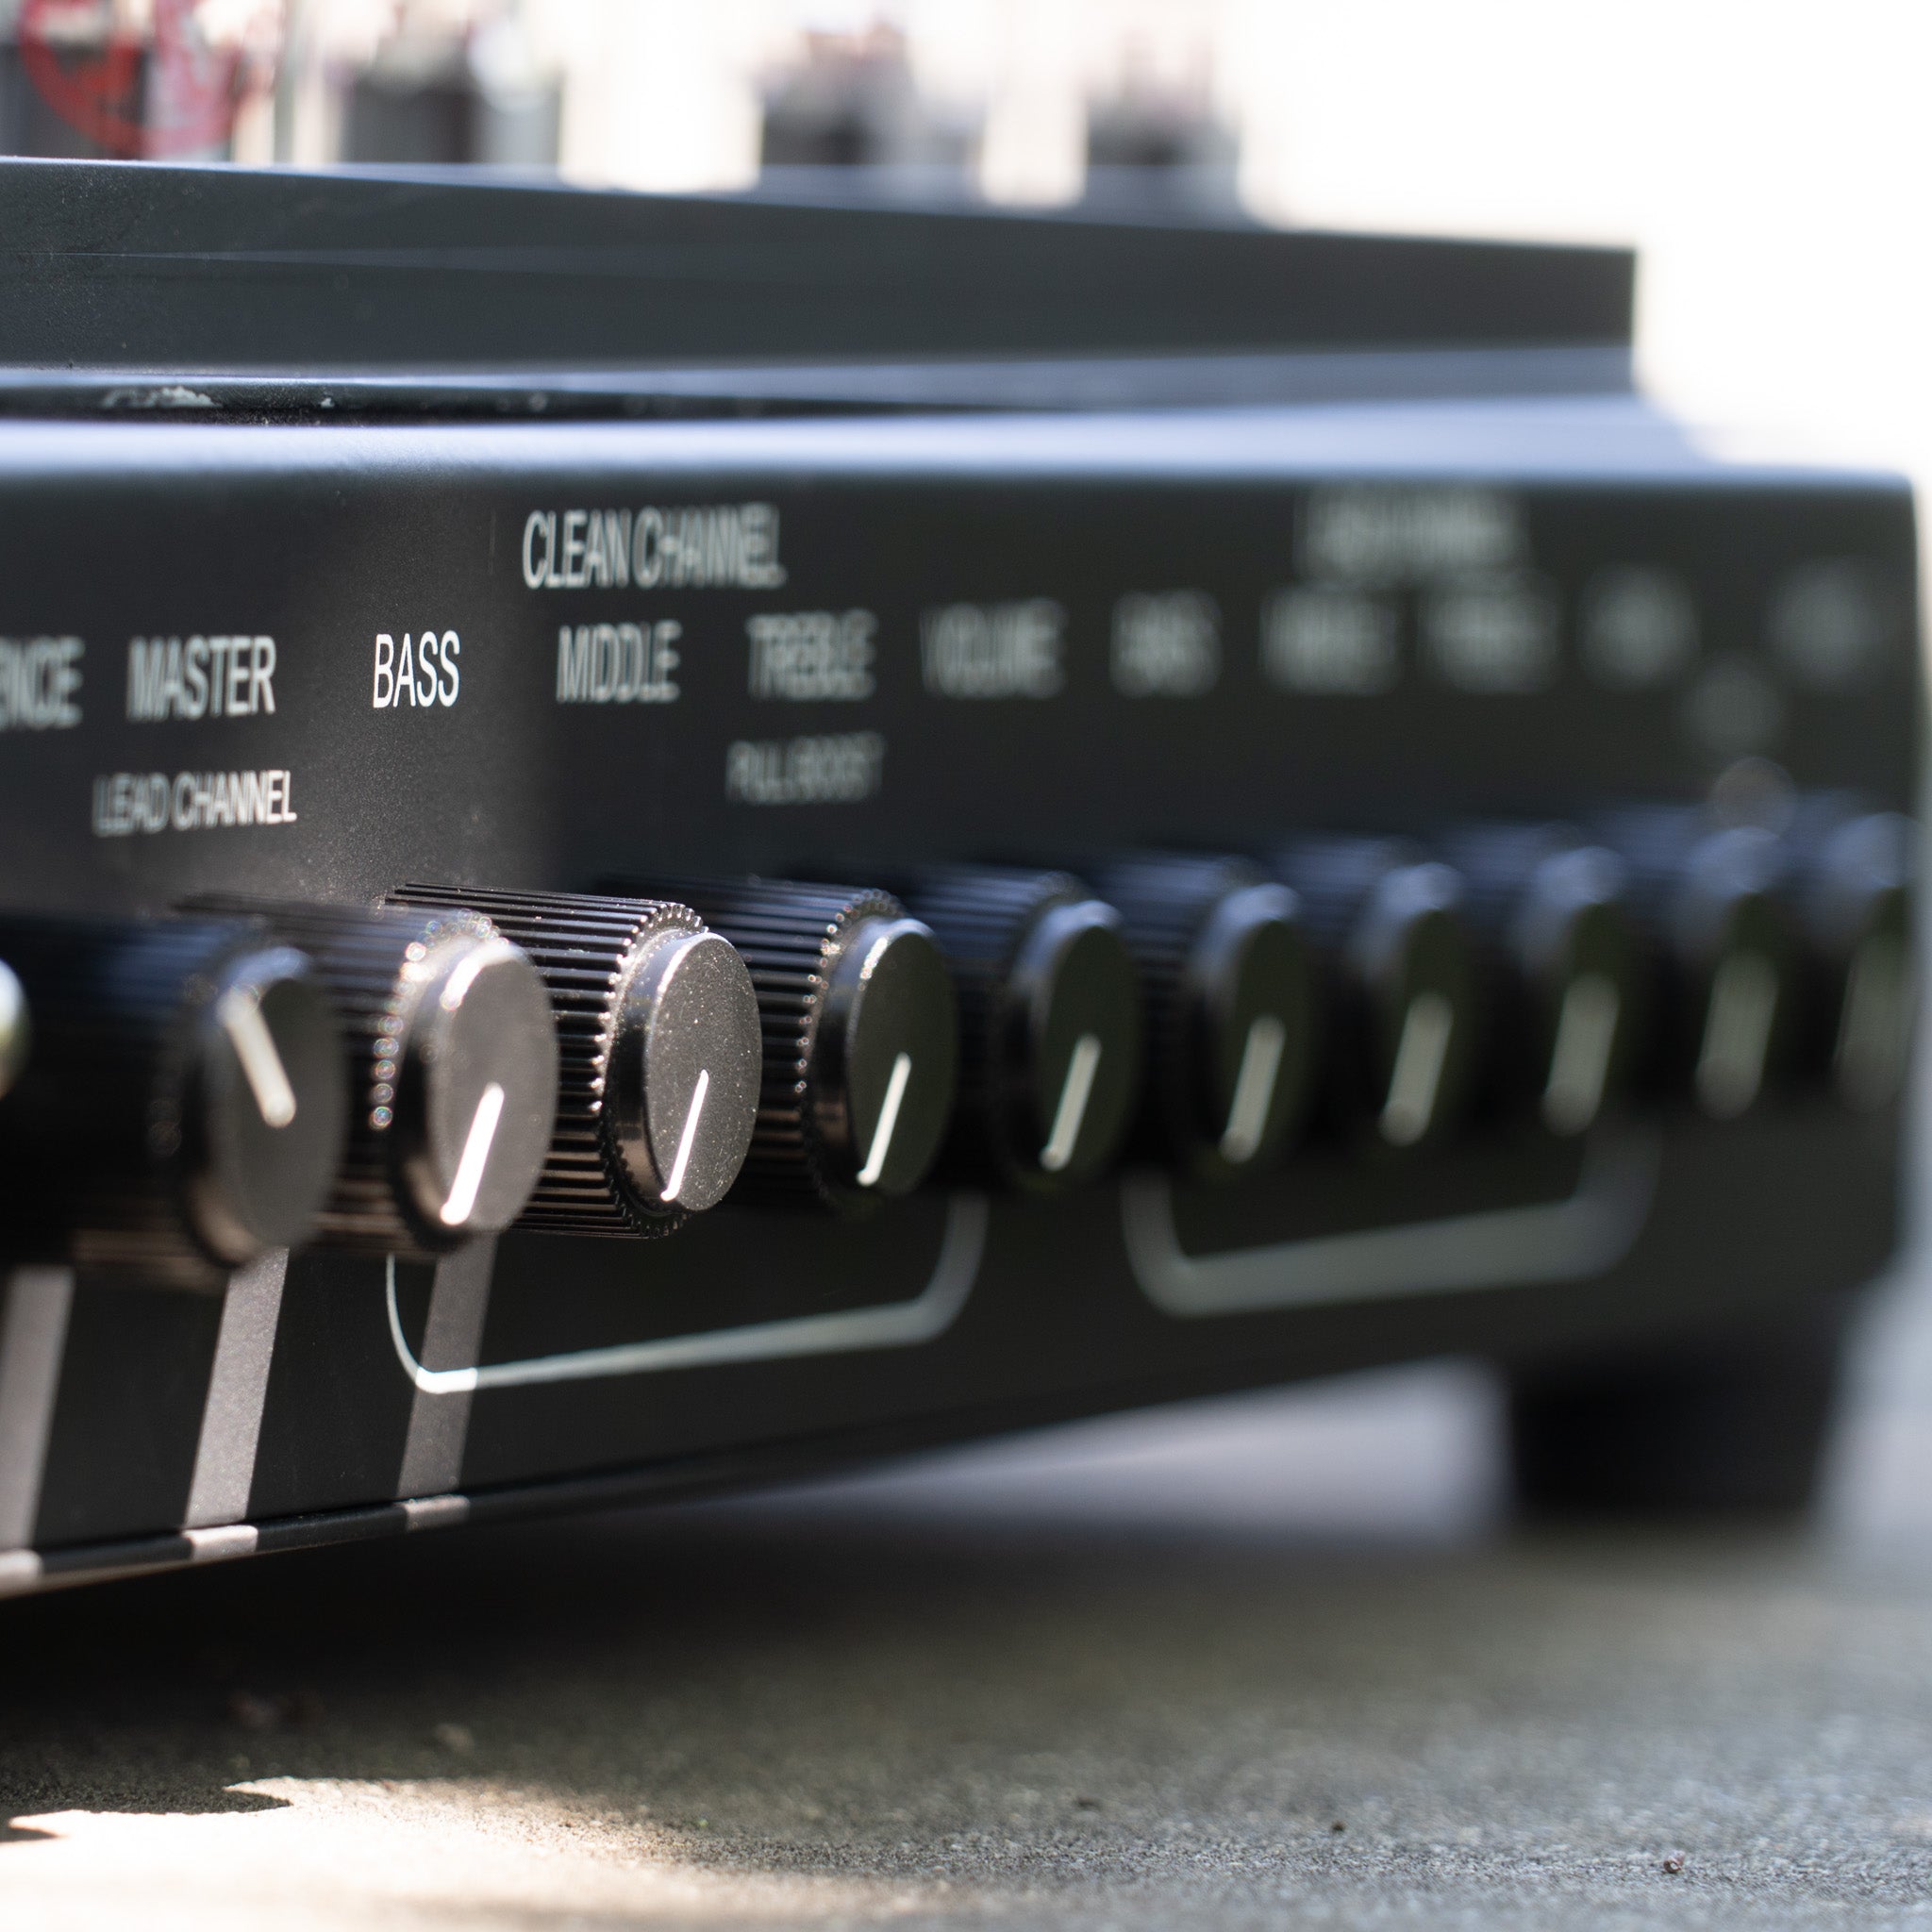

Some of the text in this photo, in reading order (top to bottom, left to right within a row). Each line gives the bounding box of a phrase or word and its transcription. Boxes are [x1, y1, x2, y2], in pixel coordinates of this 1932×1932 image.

[523, 504, 785, 589] CLEAN CHANNEL
[125, 636, 276, 721] MASTER
[374, 630, 460, 708] BASS
[557, 620, 681, 703] MIDDLE
[94, 770, 297, 837] LEAD CHANNEL
